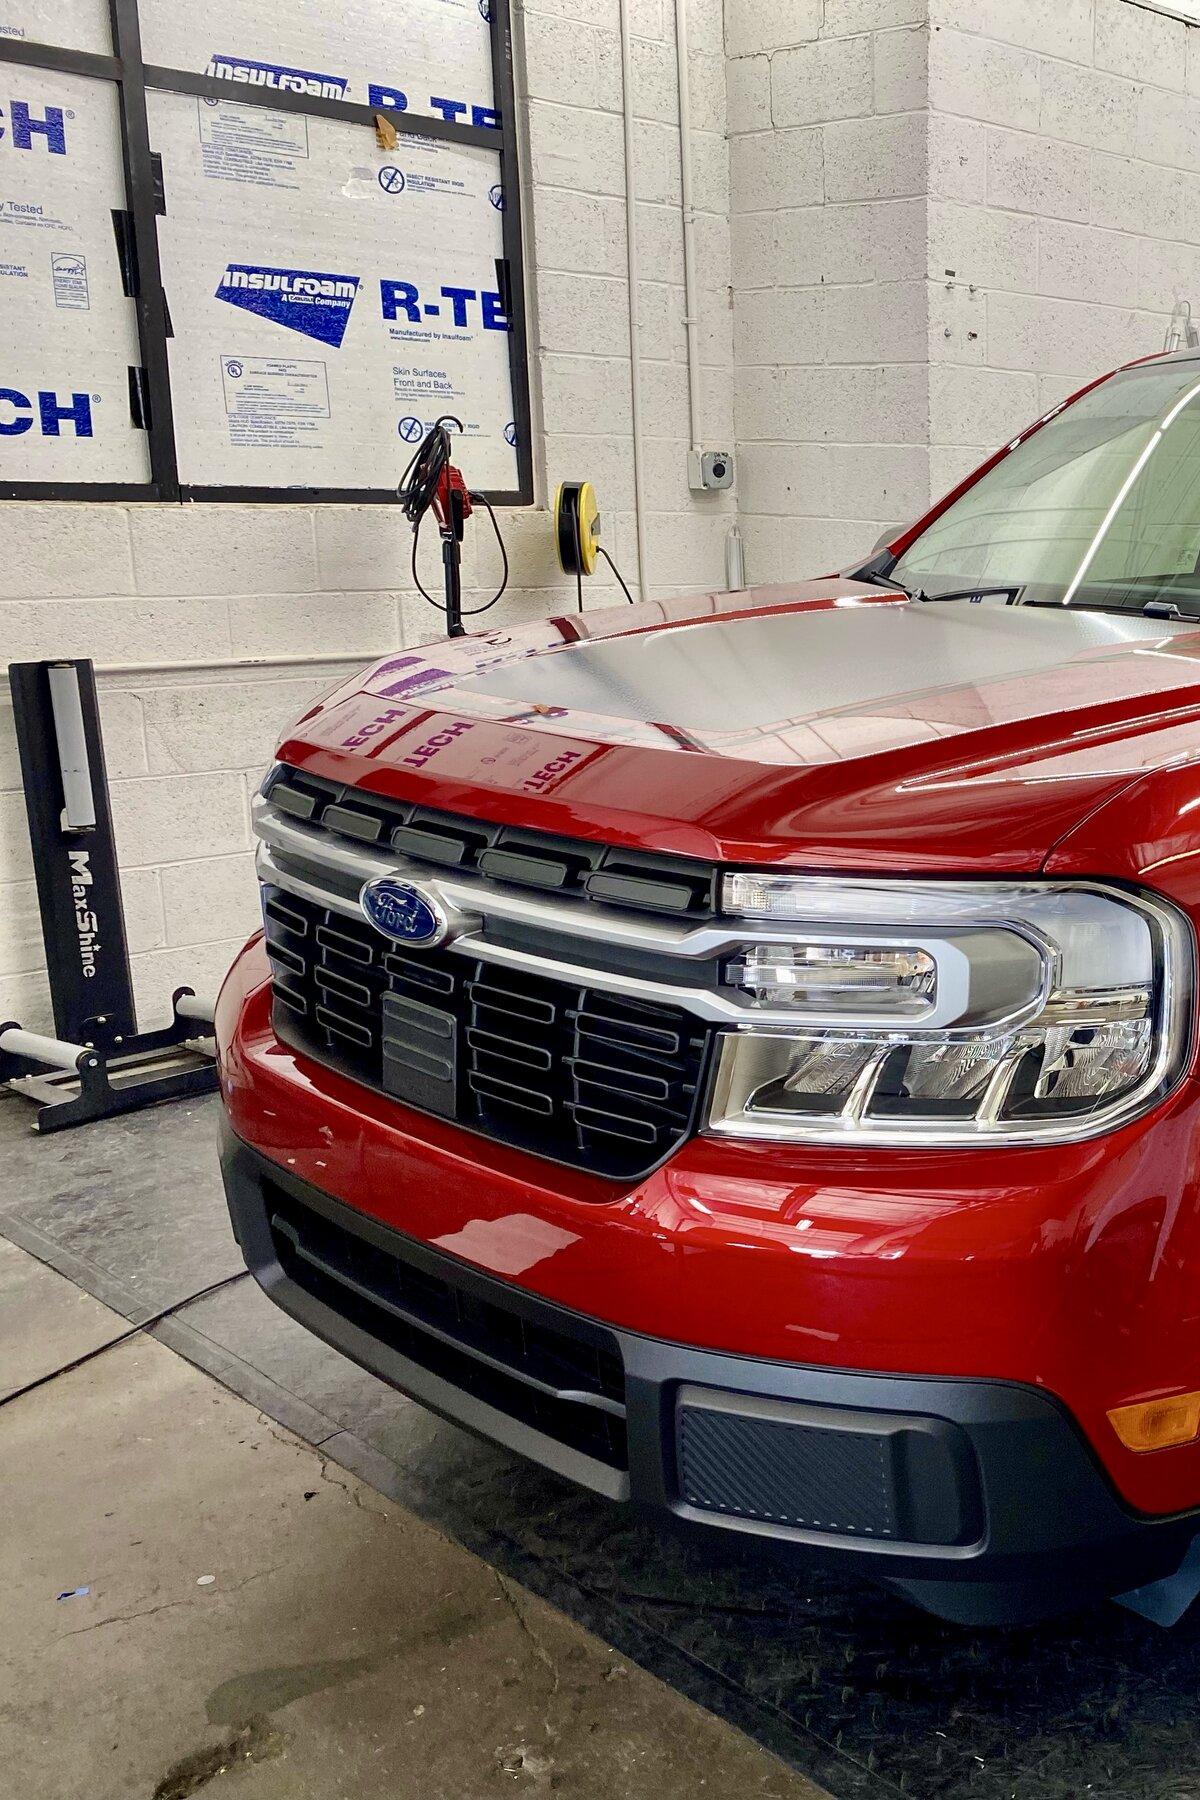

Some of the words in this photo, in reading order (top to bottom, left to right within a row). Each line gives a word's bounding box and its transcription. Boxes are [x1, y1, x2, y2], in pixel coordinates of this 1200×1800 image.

[0, 100, 67, 155] H
[7, 201, 43, 215] Tested
[315, 297, 351, 309] Company
[389, 328, 432, 338] Manufactured
[393, 366, 411, 377] Skin
[412, 367, 447, 379] Surfaces
[393, 378, 415, 388] Front
[416, 380, 432, 389] and
[433, 380, 453, 390] Back
[68, 851, 101, 978] MaxShine
[376, 892, 419, 933] Ford
